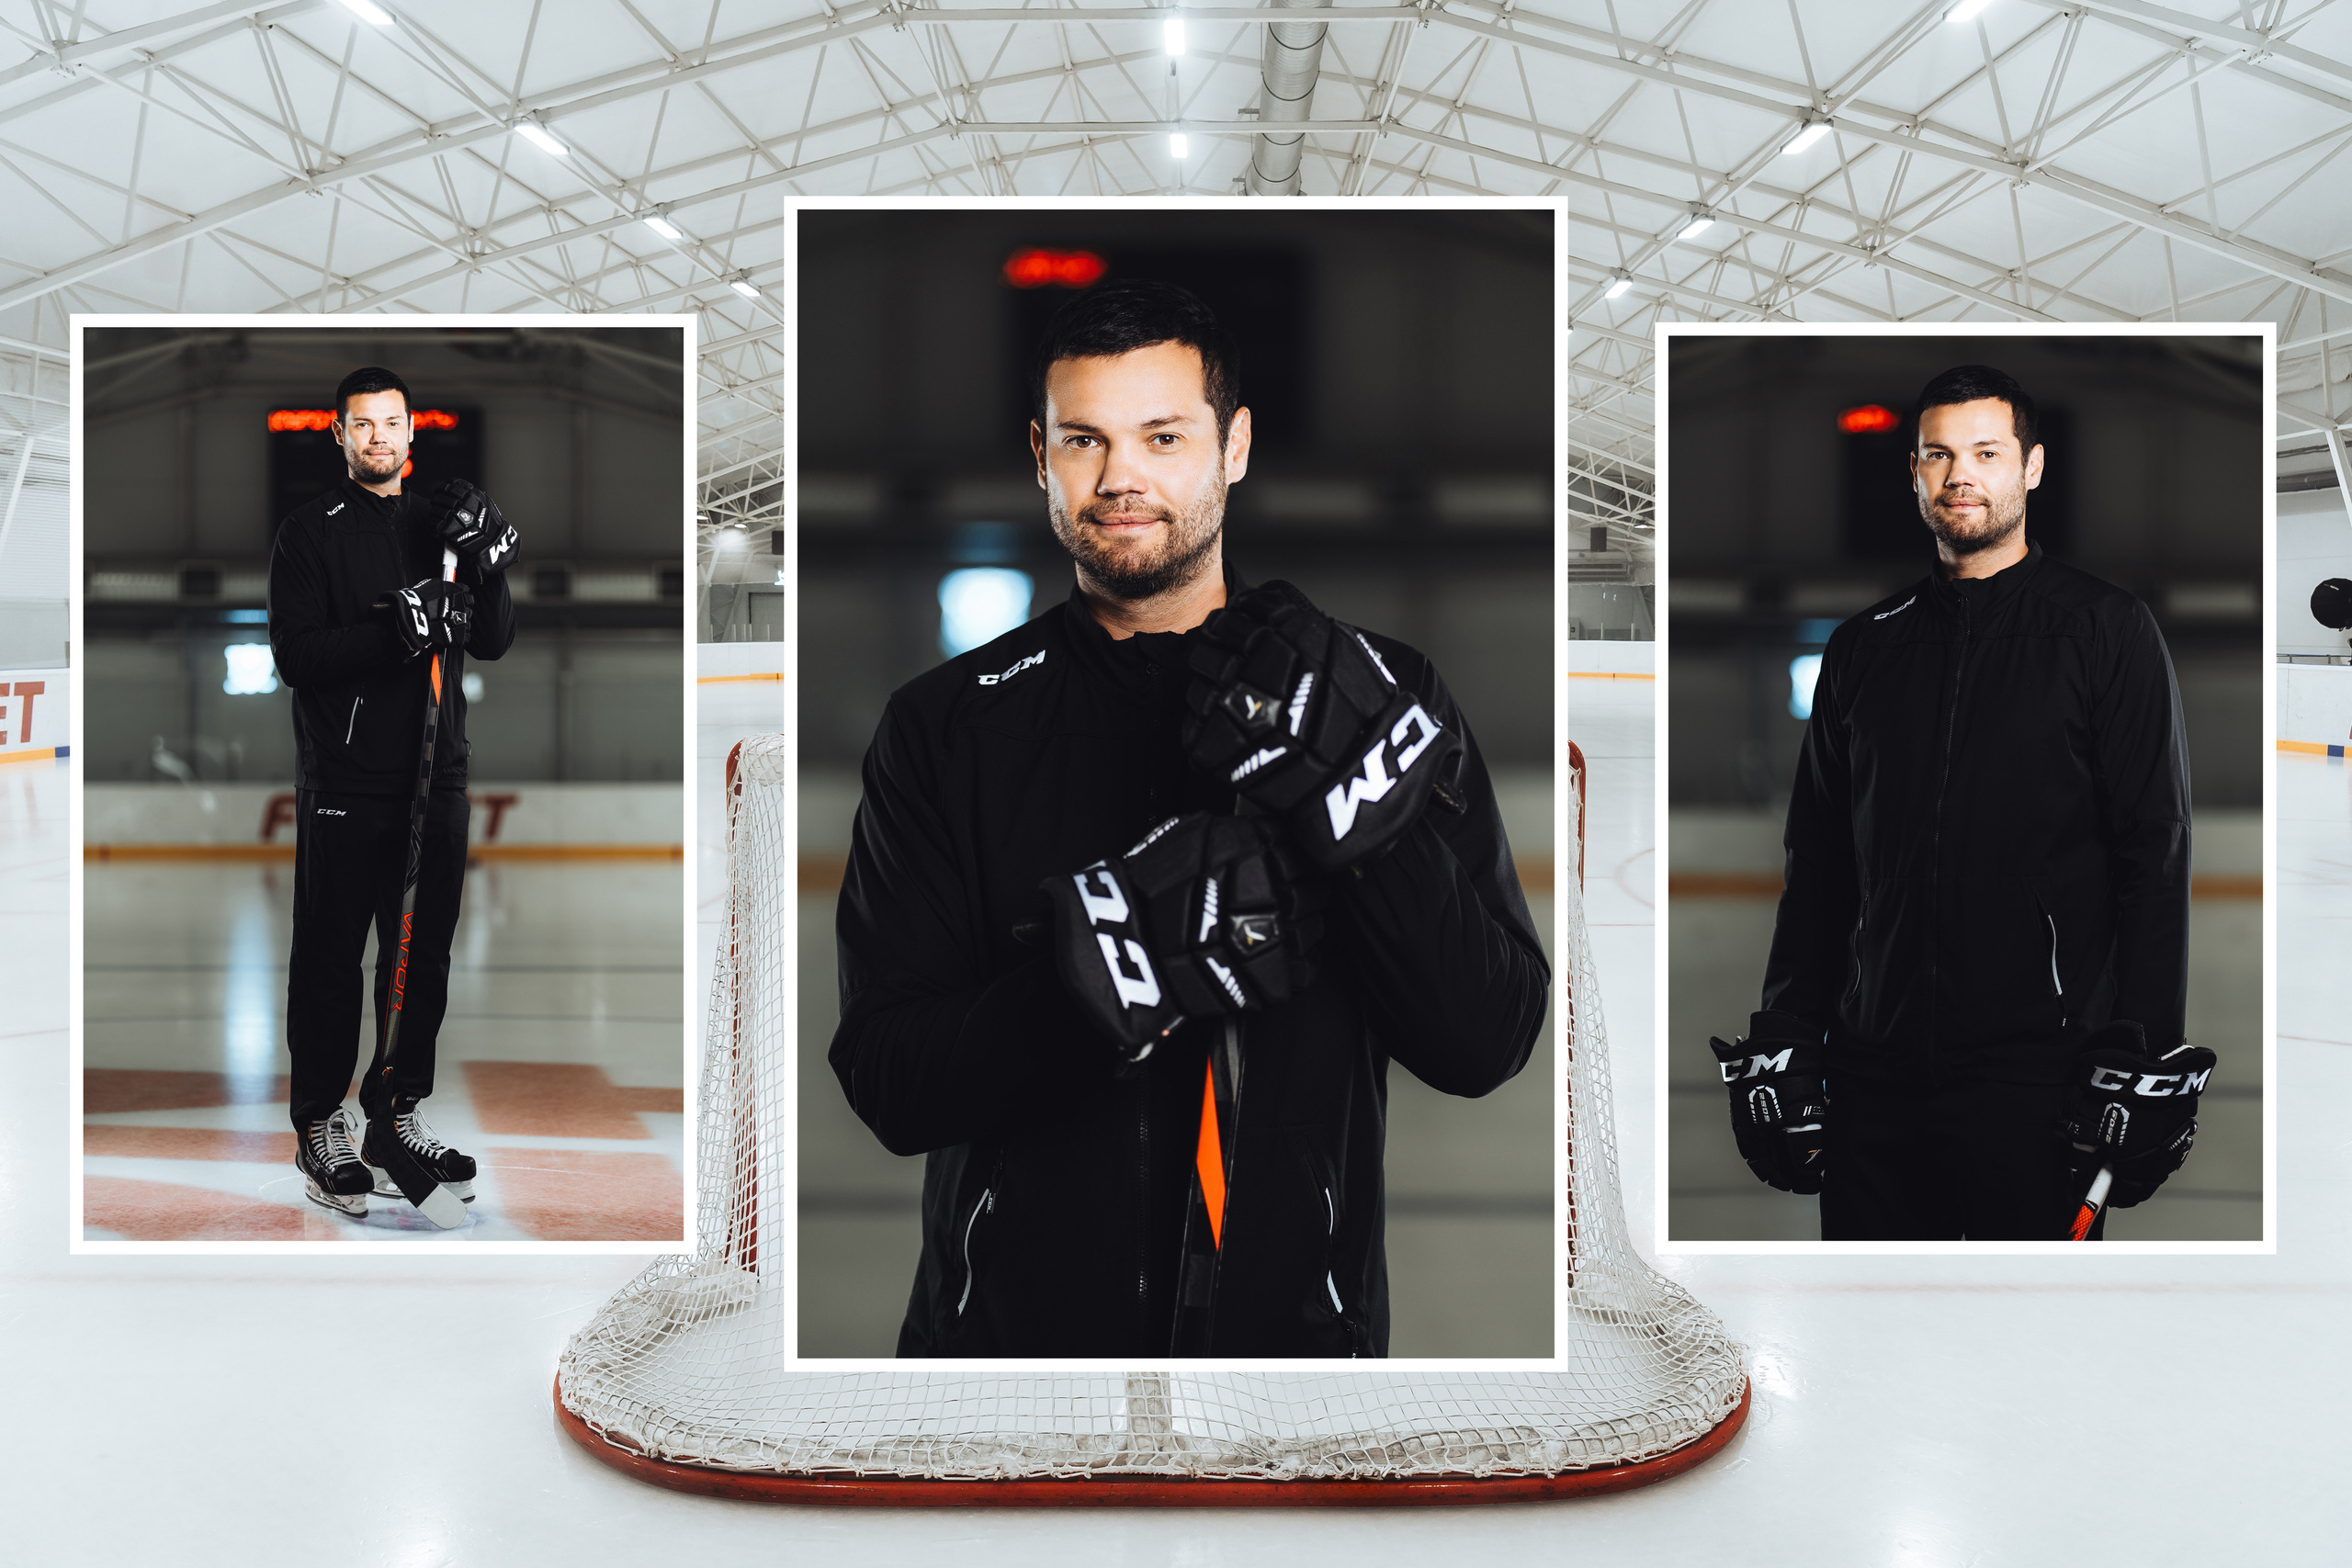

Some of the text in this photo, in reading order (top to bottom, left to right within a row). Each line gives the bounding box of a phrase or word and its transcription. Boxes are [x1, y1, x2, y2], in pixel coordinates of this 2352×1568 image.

[326, 502, 345, 516] CCM
[1873, 594, 1917, 620] CCM
[977, 649, 1046, 685] CCM
[1325, 704, 1442, 841] CM
[316, 808, 347, 817] CCM
[1072, 860, 1162, 1010] CC
[390, 911, 414, 1013] VAPOR
[1719, 1047, 1794, 1083] CM
[2090, 1066, 2212, 1097] CCM
